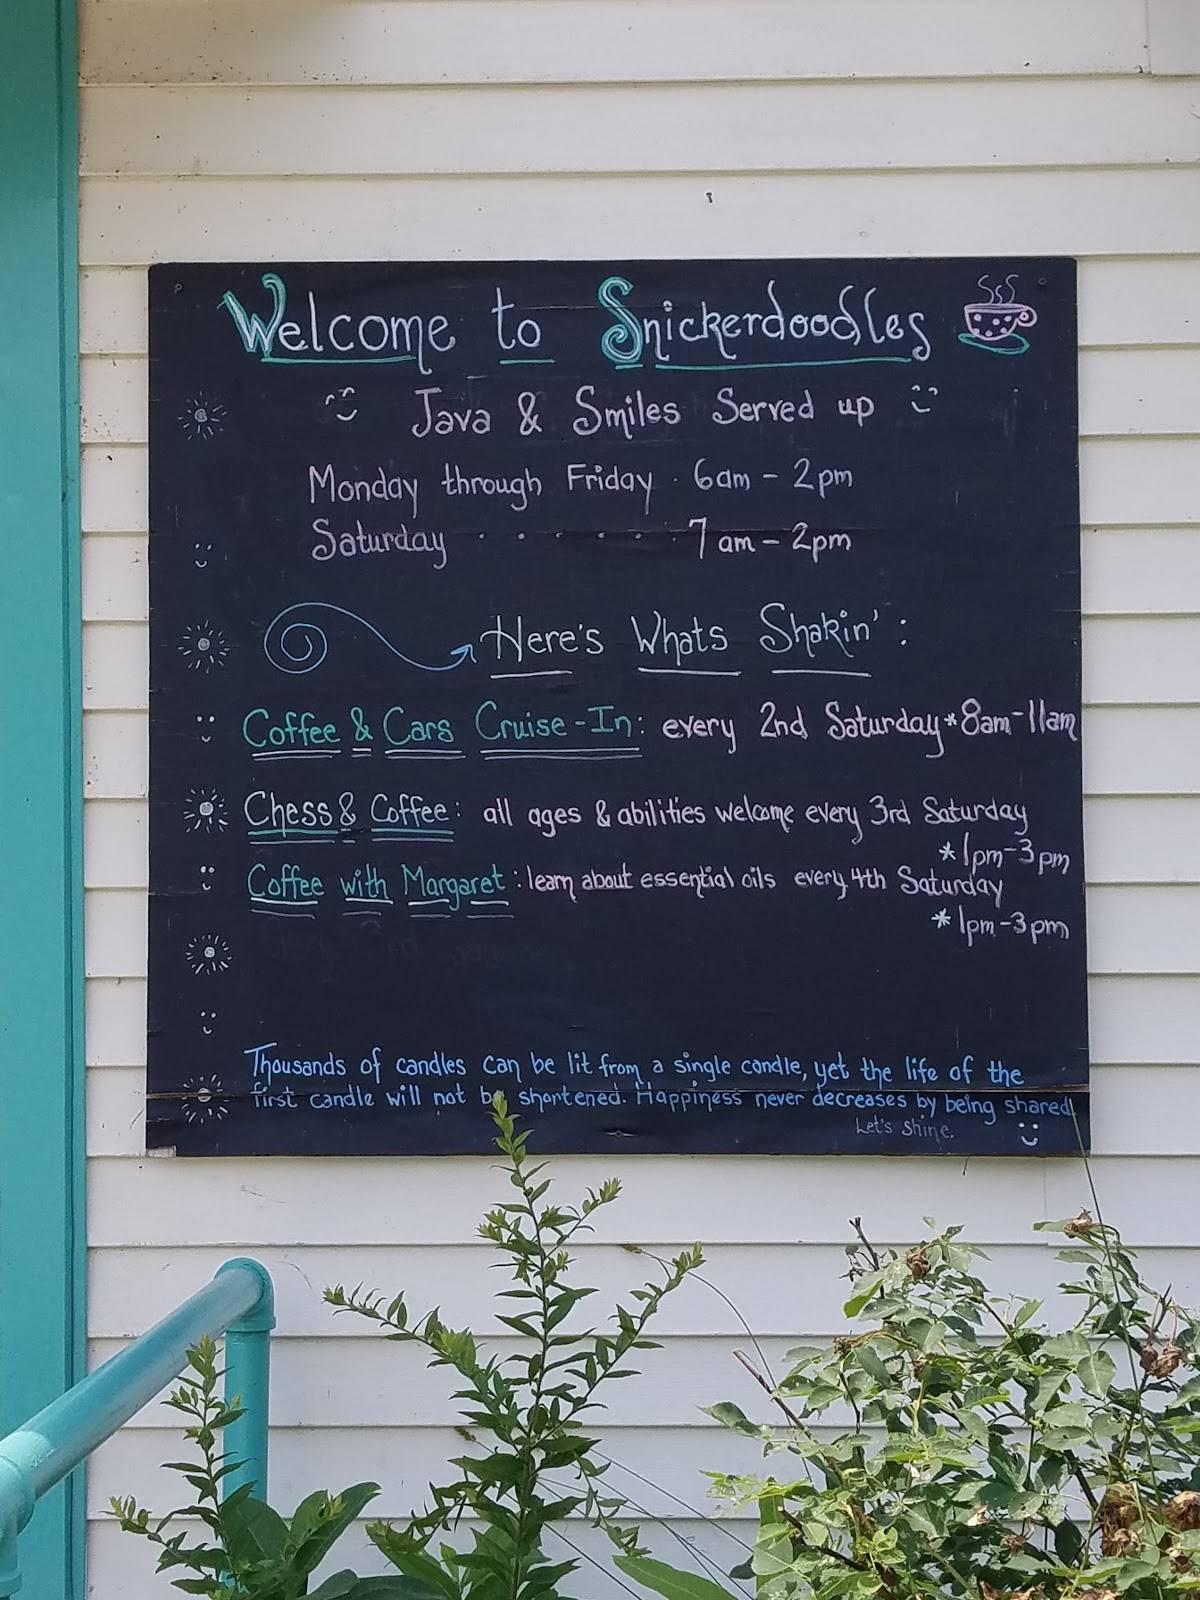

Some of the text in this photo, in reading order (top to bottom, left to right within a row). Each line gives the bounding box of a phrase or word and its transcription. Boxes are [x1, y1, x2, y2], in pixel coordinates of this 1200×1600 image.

[217, 273, 932, 375] Welcome to Snickerdoodles
[412, 386, 875, 439] Java & Smiles Served up
[309, 464, 418, 518] Monday
[441, 463, 543, 511] through
[568, 464, 653, 515] Friday
[312, 518, 448, 569] Saturday
[480, 615, 605, 662] Here's
[631, 611, 728, 666] Whats
[243, 709, 341, 747] Coffee
[351, 707, 374, 741] &
[383, 706, 455, 745] Cars
[663, 715, 737, 754] every
[760, 702, 808, 739] 2nd
[244, 791, 333, 837] Chess
[484, 798, 513, 824] all
[528, 808, 582, 837] ages
[618, 797, 706, 826] abilities
[715, 794, 794, 833] welcome
[805, 805, 863, 845] every
[869, 795, 911, 825] 3rd
[923, 796, 1029, 836] Saturday
[248, 863, 325, 897] Coffee
[340, 864, 390, 899] with
[581, 862, 634, 890] about
[640, 865, 735, 898] essential
[742, 866, 777, 889] oils
[794, 870, 849, 900] every
[851, 868, 887, 889] 4th
[897, 866, 1003, 908] Saturday
[244, 1043, 346, 1084] Thousands
[360, 1047, 382, 1084] of
[396, 1051, 467, 1077] candles
[483, 1055, 524, 1083] can
[531, 1052, 556, 1075] be
[568, 1052, 594, 1075] lit
[598, 1053, 641, 1085] from
[652, 1059, 664, 1074] a
[674, 1051, 731, 1082] single
[813, 1052, 850, 1089] yet
[860, 1056, 894, 1088] the
[906, 1056, 939, 1083] life
[950, 1055, 975, 1085] of
[987, 1058, 1025, 1085] the
[250, 1083, 299, 1108] first
[310, 1084, 375, 1108] candle
[386, 1084, 421, 1106] will
[434, 1083, 467, 1107] not
[480, 1085, 507, 1105] b
[636, 1081, 742, 1112] Happiness
[755, 1091, 805, 1109] never
[813, 1087, 907, 1108] decreases
[916, 1090, 937, 1118] by
[946, 1094, 996, 1125] being
[856, 1114, 893, 1134] Let's
